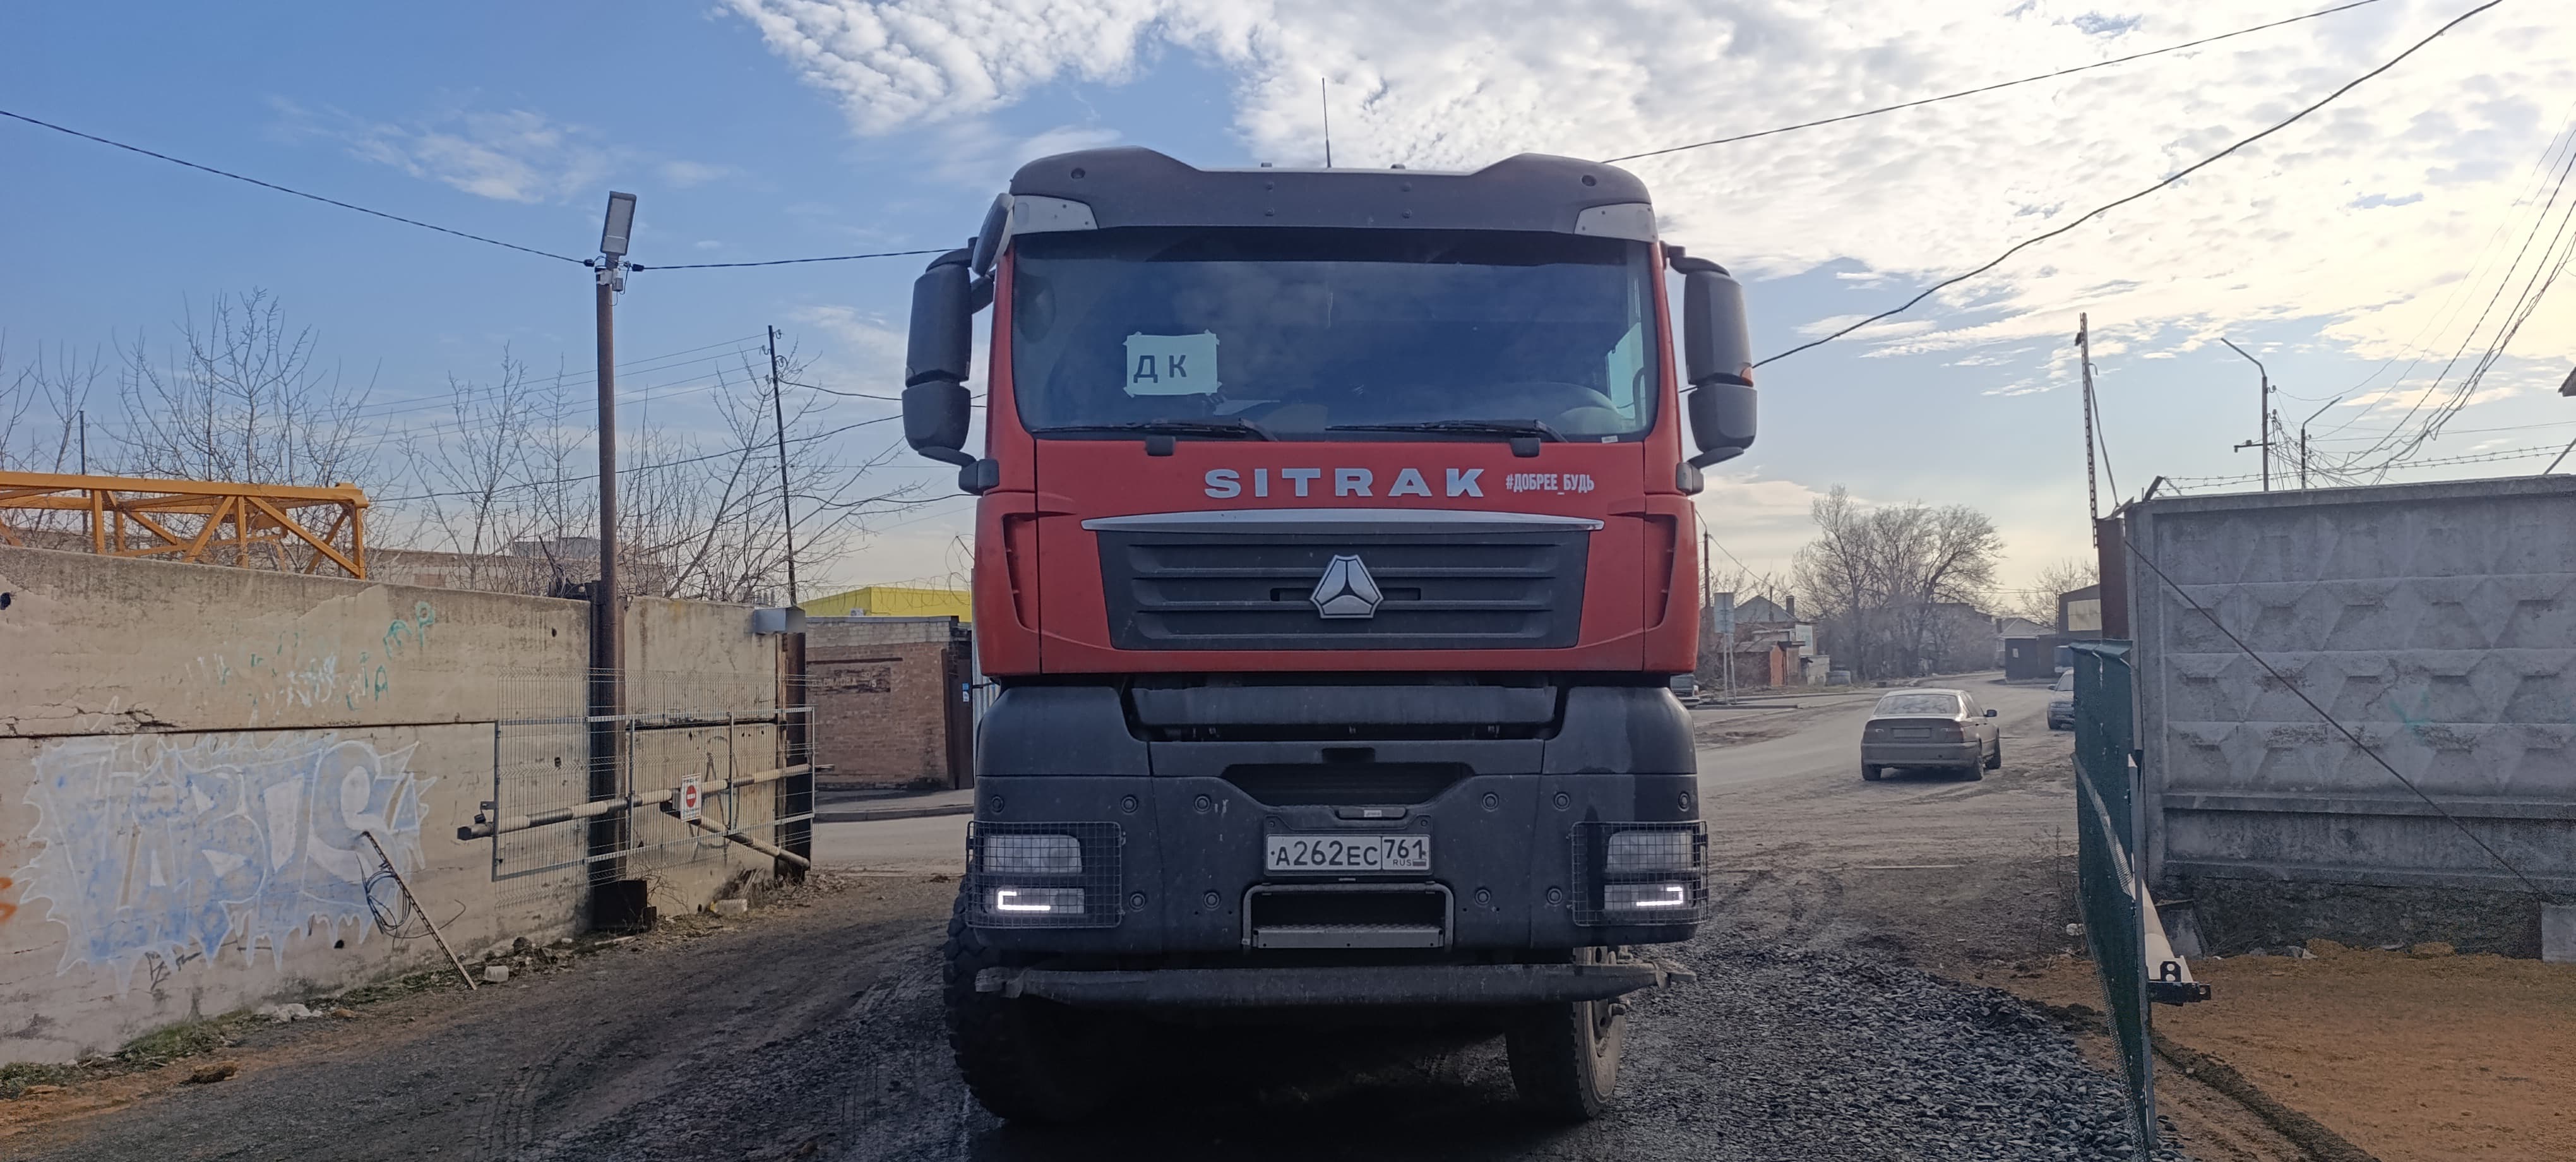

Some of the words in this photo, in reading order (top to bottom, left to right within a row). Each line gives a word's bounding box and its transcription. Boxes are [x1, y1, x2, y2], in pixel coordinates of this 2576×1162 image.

[1205, 468, 1484, 499] SITRAK
[1506, 474, 1594, 495] #ДОБРЕЕ_БУДЬ
[1276, 841, 1378, 866] А262ЕС
[1383, 839, 1424, 859] 761
